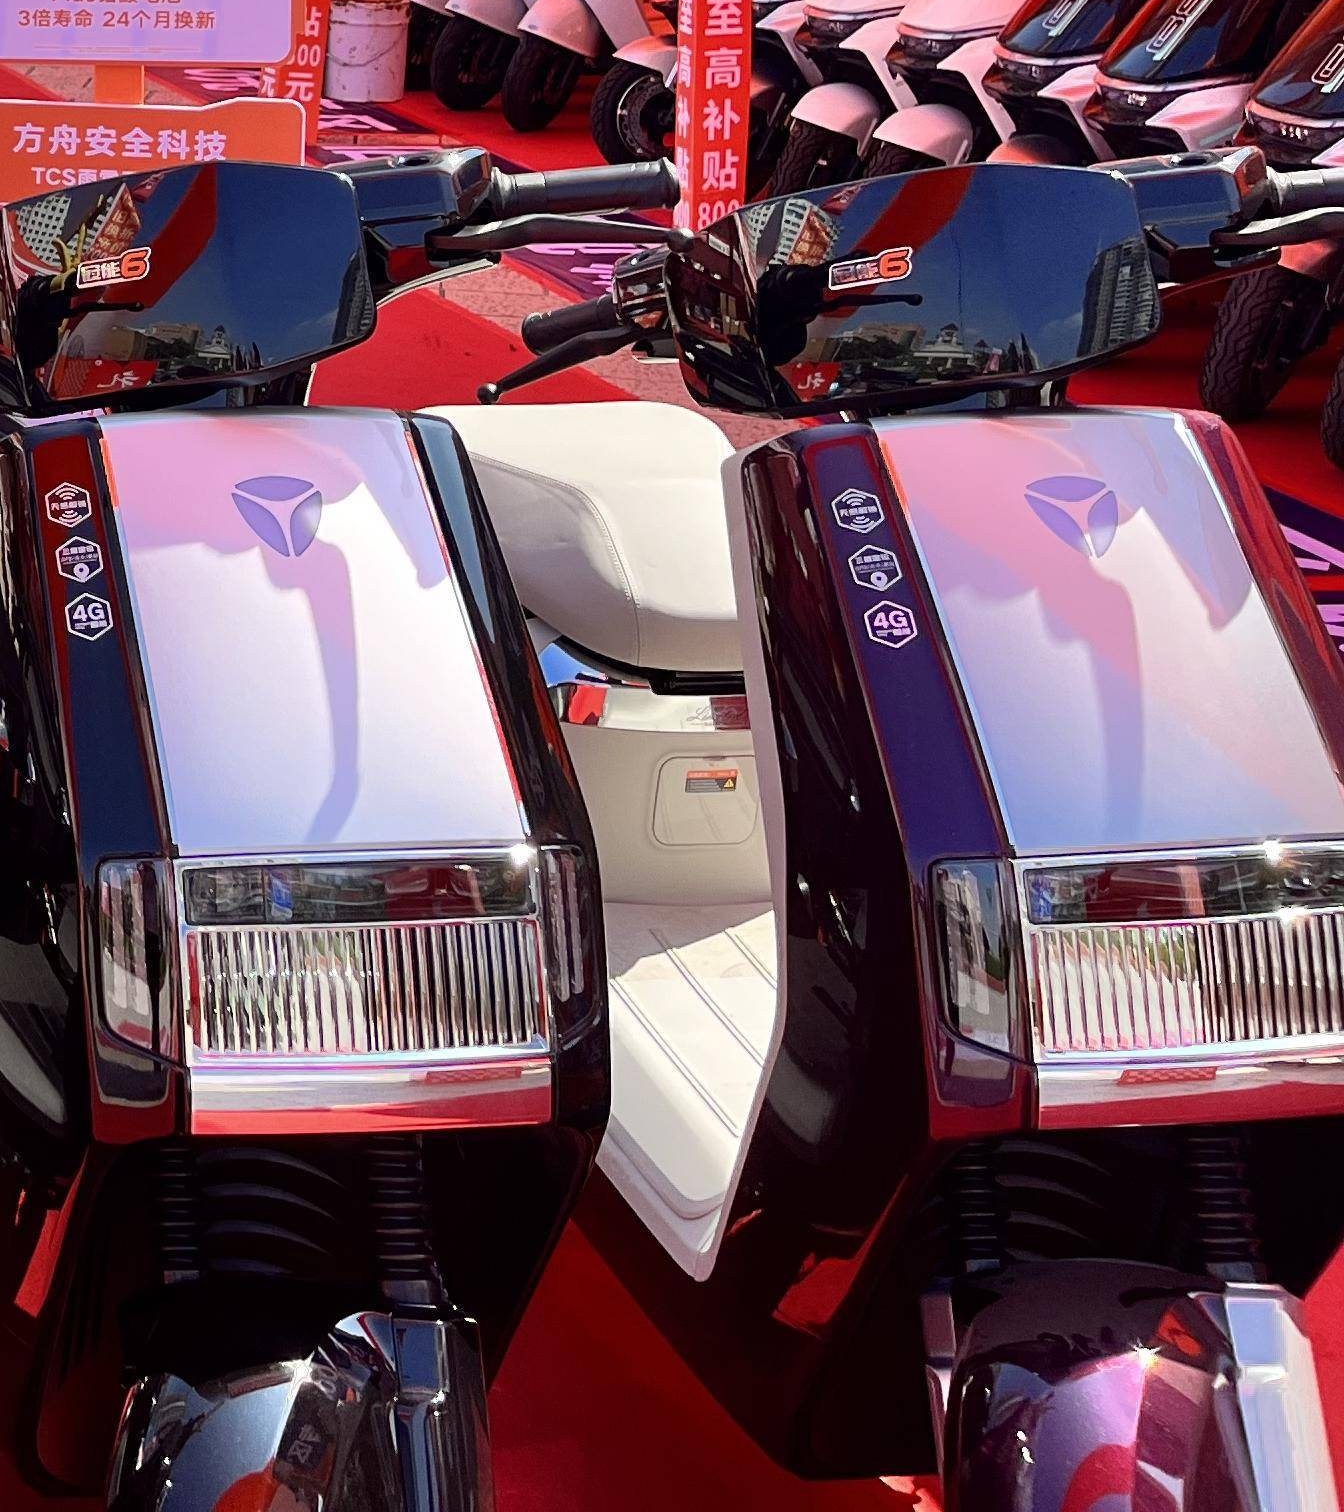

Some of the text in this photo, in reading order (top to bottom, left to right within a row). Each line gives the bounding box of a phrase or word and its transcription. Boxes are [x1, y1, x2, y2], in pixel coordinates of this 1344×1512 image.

[17, 9, 217, 30] 3倍寿命 24个月换新
[14, 123, 228, 162] 方舟安全科技
[80, 249, 150, 283] 冠能6
[72, 601, 105, 621] 4G
[873, 609, 908, 628] 4G
